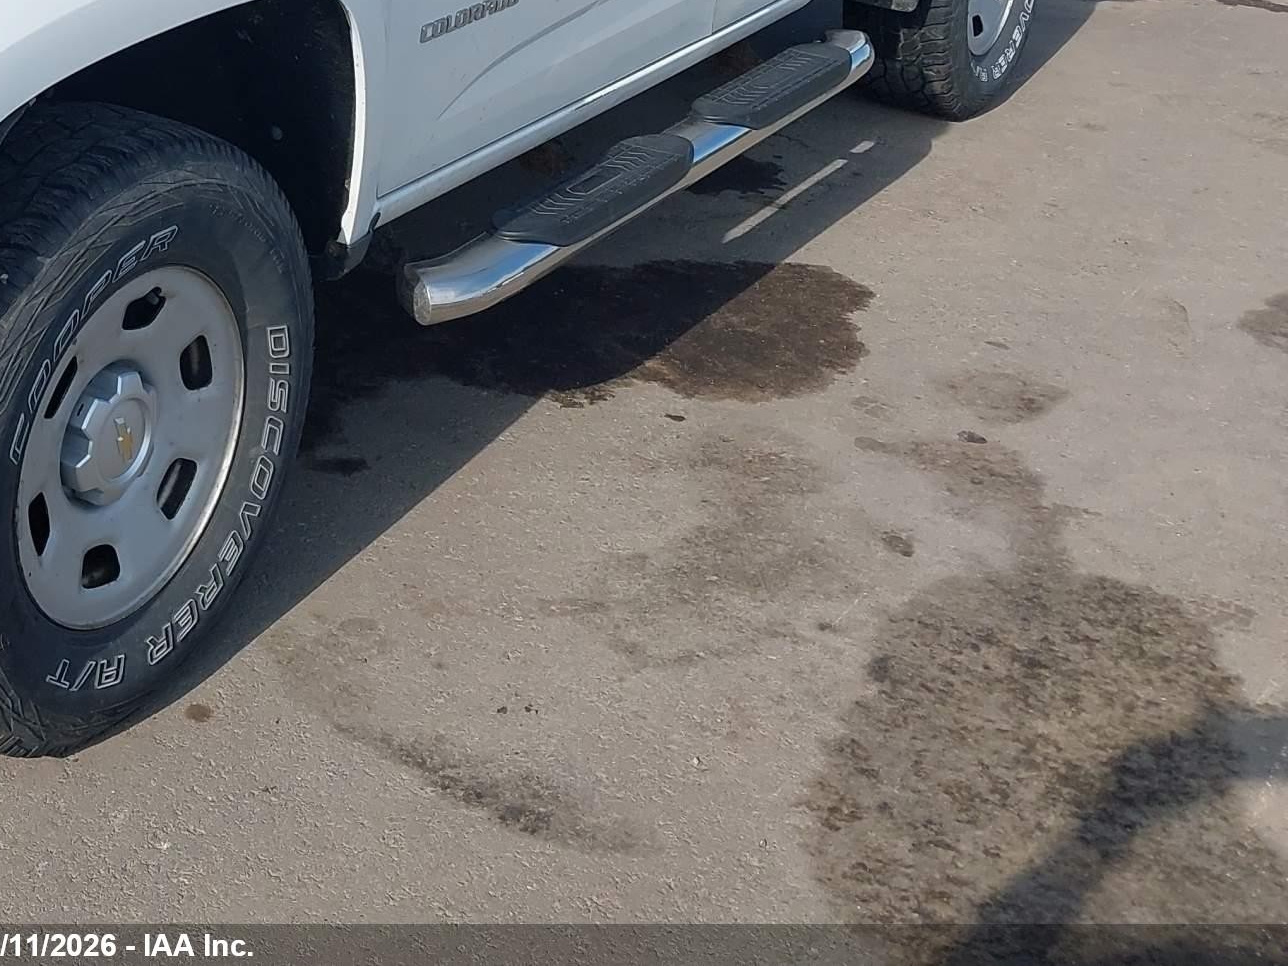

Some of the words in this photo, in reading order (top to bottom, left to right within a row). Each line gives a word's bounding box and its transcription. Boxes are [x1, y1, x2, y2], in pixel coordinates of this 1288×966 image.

[10, 225, 178, 465] COOPER
[147, 325, 291, 666] DISCOVERER
[46, 654, 126, 691] A/T
